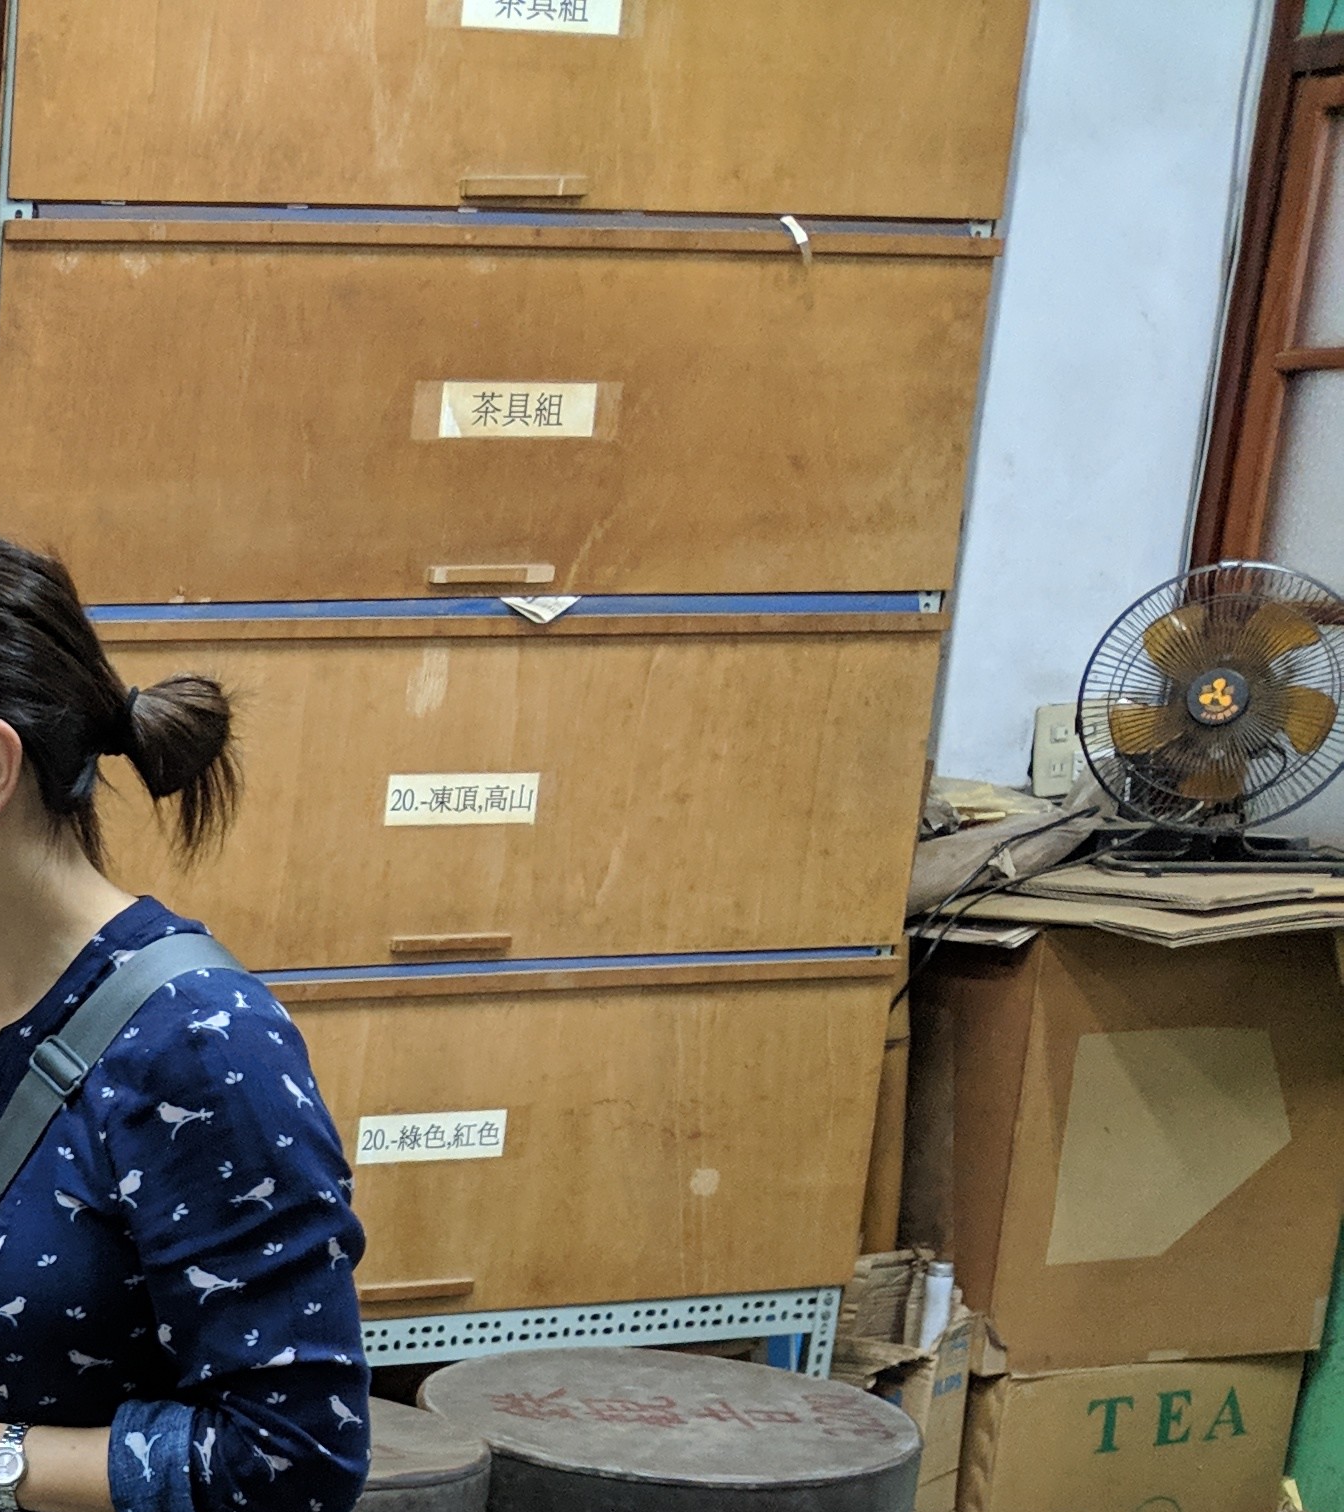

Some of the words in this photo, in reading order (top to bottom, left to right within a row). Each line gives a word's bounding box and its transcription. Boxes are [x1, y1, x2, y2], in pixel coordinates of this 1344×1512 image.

[470, 391, 564, 428] 茶具組
[1086, 1385, 1247, 1455] TEA
